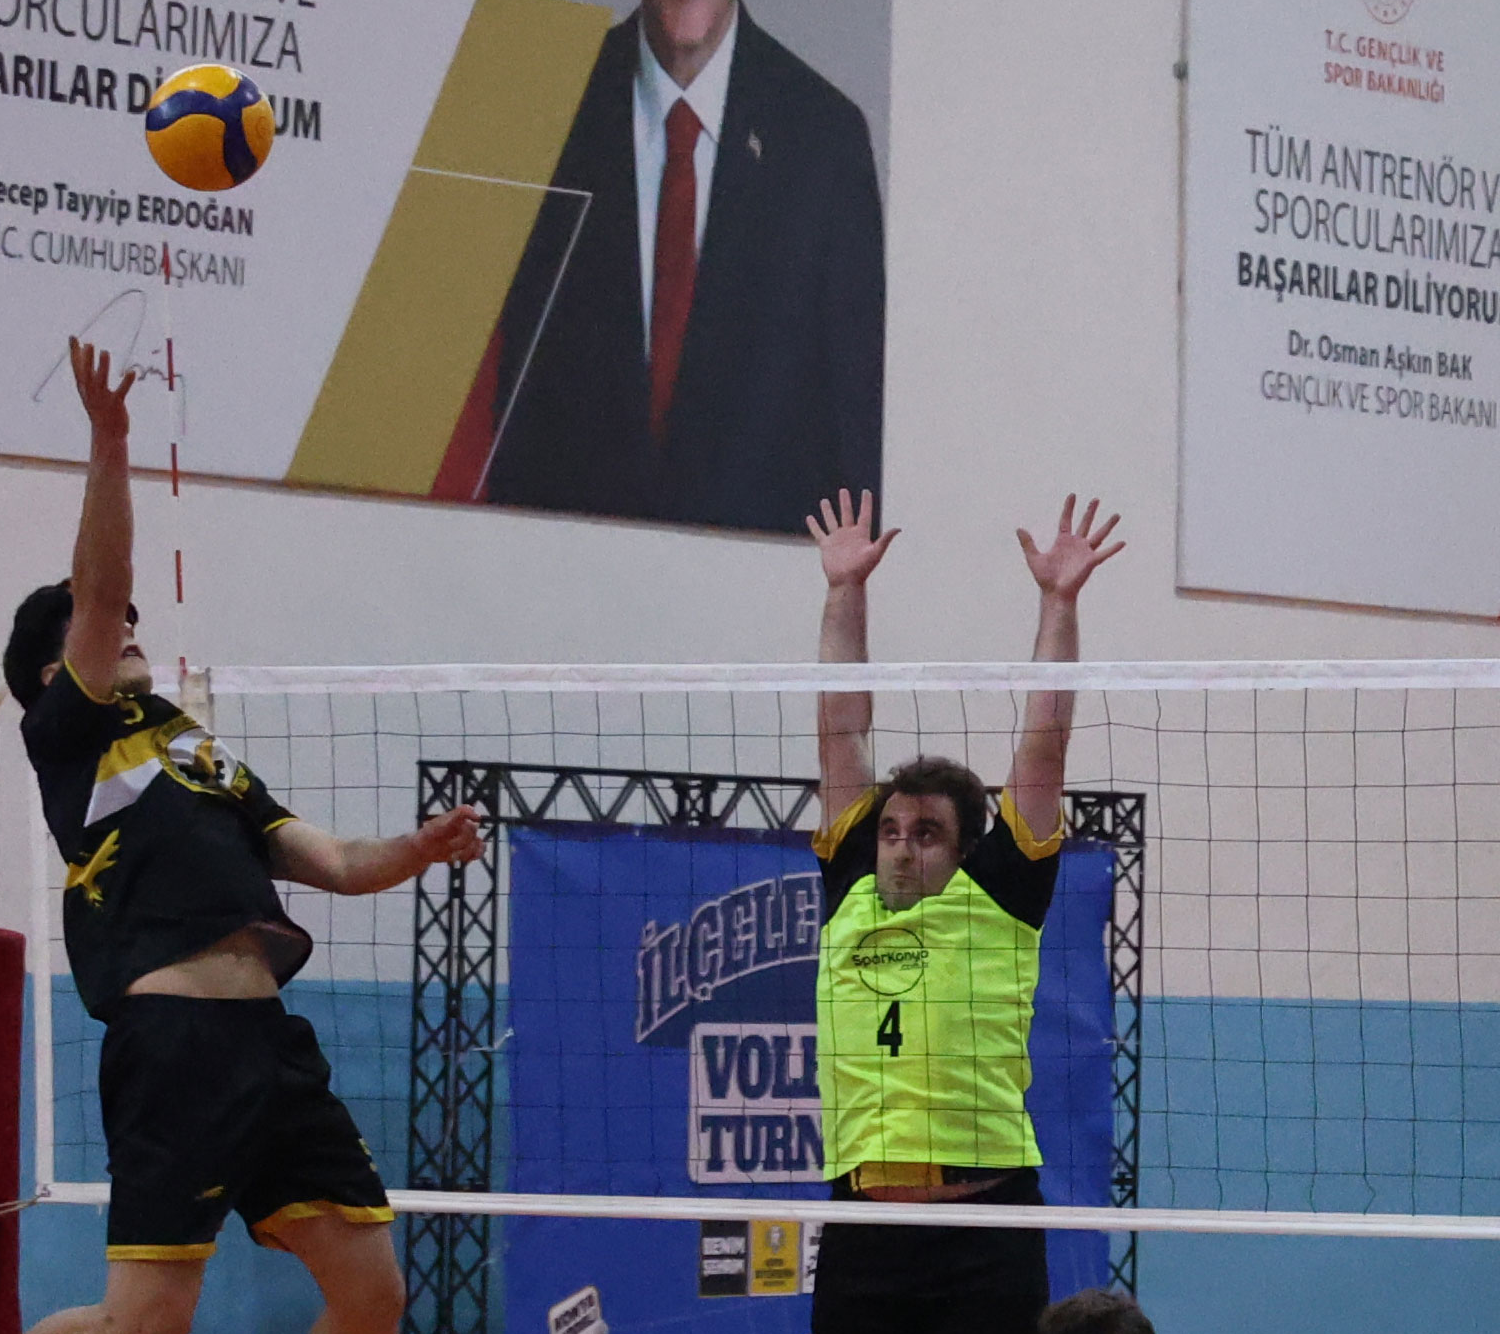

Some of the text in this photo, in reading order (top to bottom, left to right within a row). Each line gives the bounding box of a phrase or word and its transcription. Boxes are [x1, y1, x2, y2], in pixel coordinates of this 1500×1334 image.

[1324, 62, 1445, 102] SPOR BAKANLIĞI
[1426, 50, 1444, 72] VE
[1245, 124, 1312, 183] TÜM
[1321, 143, 1475, 211] ANTRENÖR
[54, 180, 131, 227] Tayyip
[137, 197, 255, 237] ERDOĞAN
[1238, 251, 1379, 305] BAŞARILAR
[1288, 329, 1473, 381] Dr. Osman Aşkın BAK
[1347, 380, 1369, 415] VE
[1375, 385, 1424, 420] SPOR
[1429, 392, 1498, 430] BAKANI
[876, 1000, 903, 1057] 4
